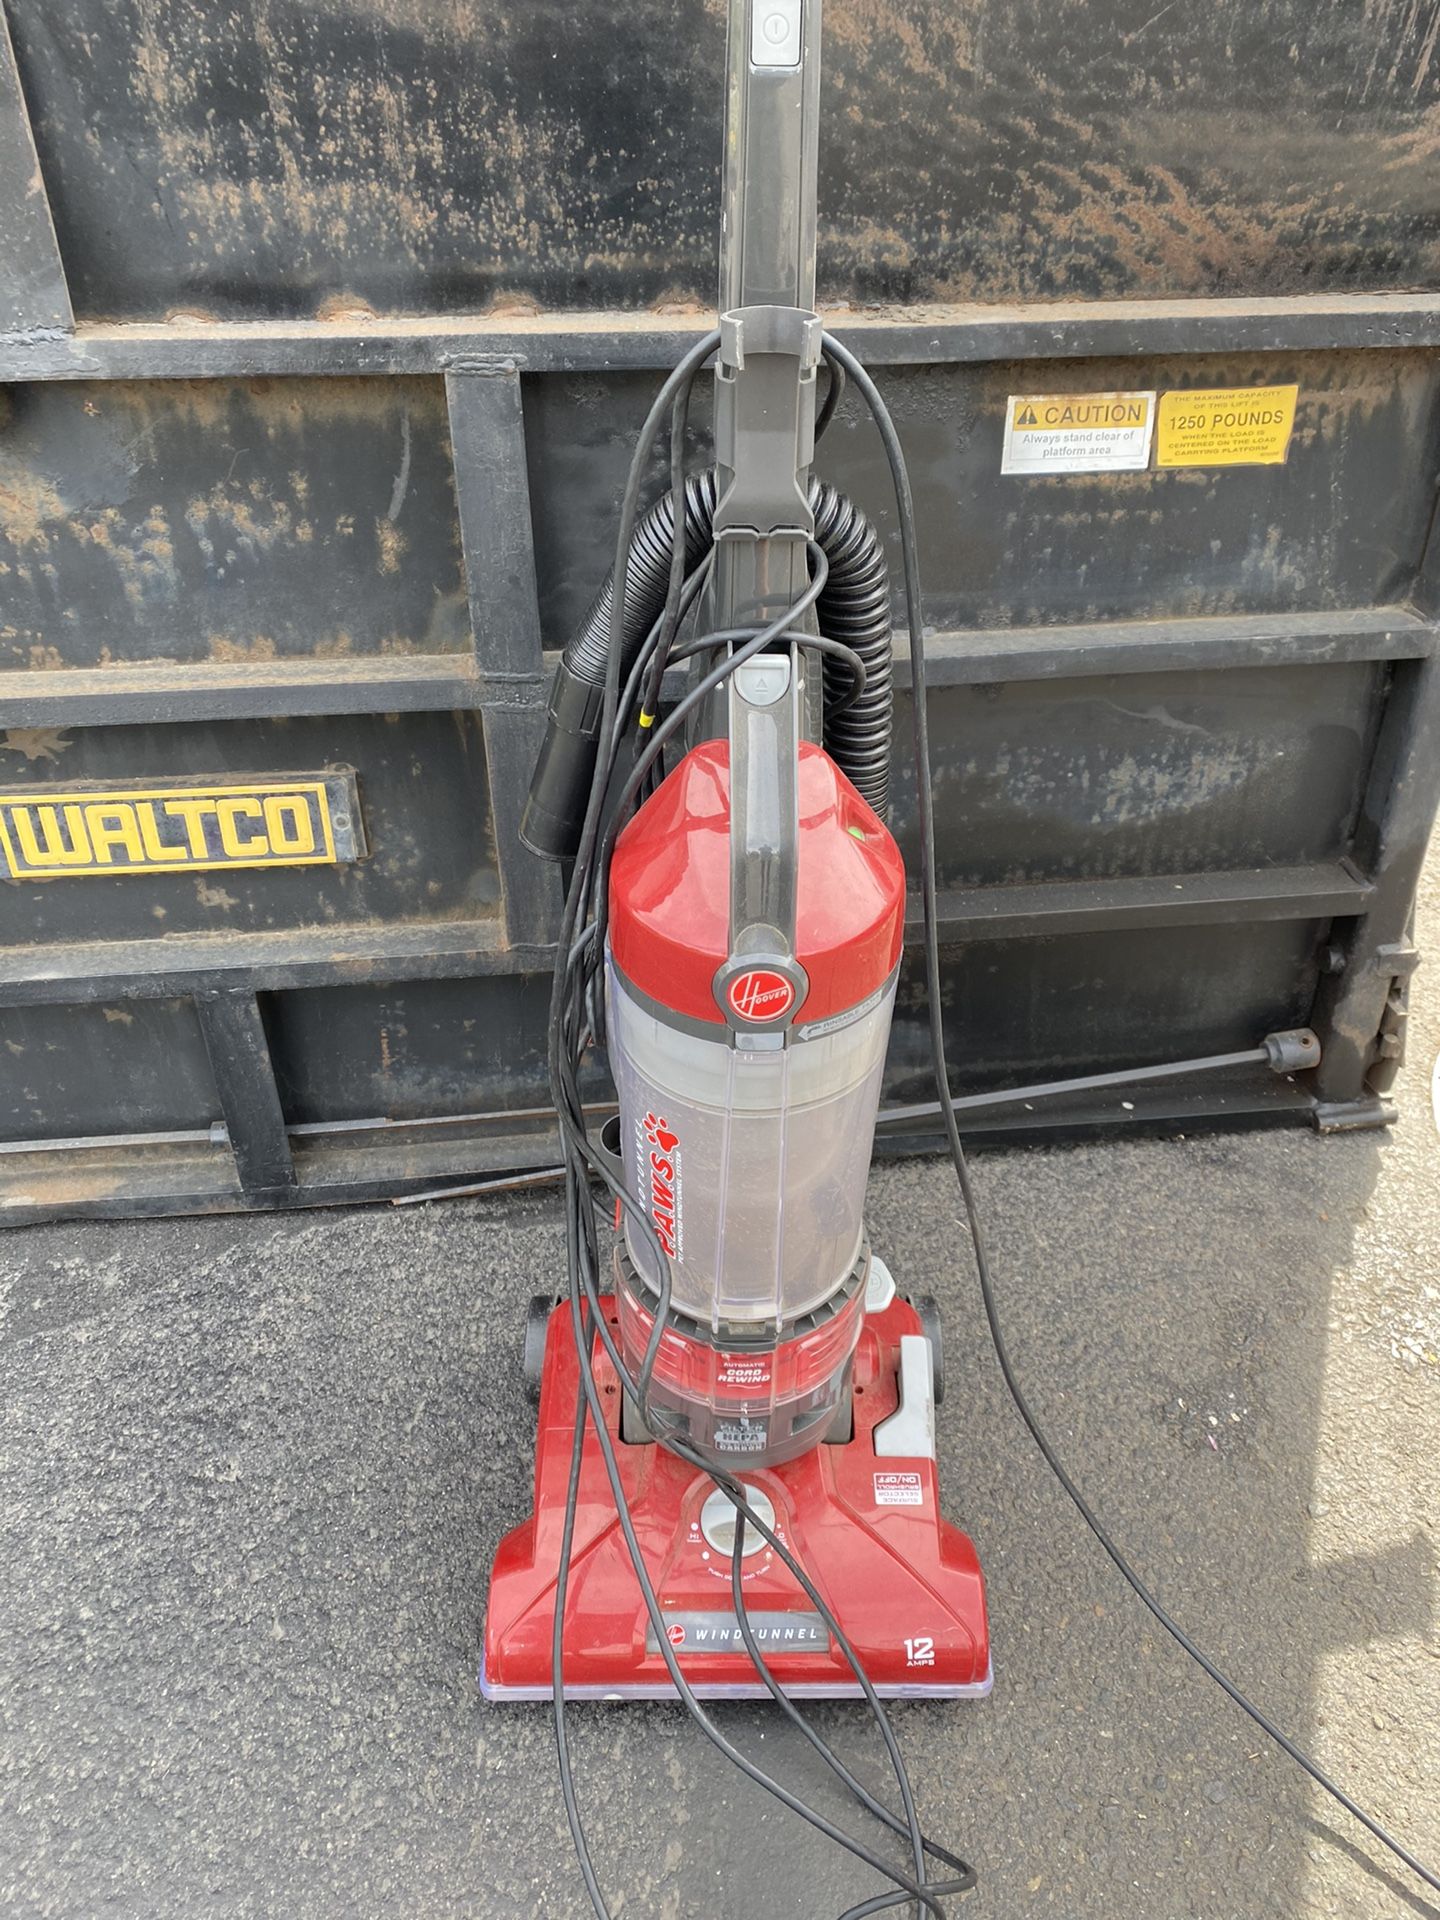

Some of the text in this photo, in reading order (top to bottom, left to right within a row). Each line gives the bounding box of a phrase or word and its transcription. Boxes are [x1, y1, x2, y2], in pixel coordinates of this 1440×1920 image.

[1193, 394, 1236, 402] MAXIMUM
[1238, 390, 1282, 399] CAPACITY
[1044, 404, 1142, 424] CAUTION
[1169, 409, 1284, 430] 1250 POUNDS
[1022, 430, 1135, 444] Always stand clear of
[1230, 430, 1254, 438] LOAD
[1168, 441, 1214, 449] CENTERED
[1174, 448, 1220, 456] CARRYING
[1222, 445, 1269, 454] PLATFORM
[1042, 446, 1112, 459] platform area
[11, 796, 315, 865] WALTCO
[717, 1375, 771, 1383] REWIND
[723, 1433, 759, 1441] HEPA
[877, 1475, 917, 1484] ON/OFF
[903, 1637, 935, 1660] 12
[906, 1659, 935, 1667] AMPS
